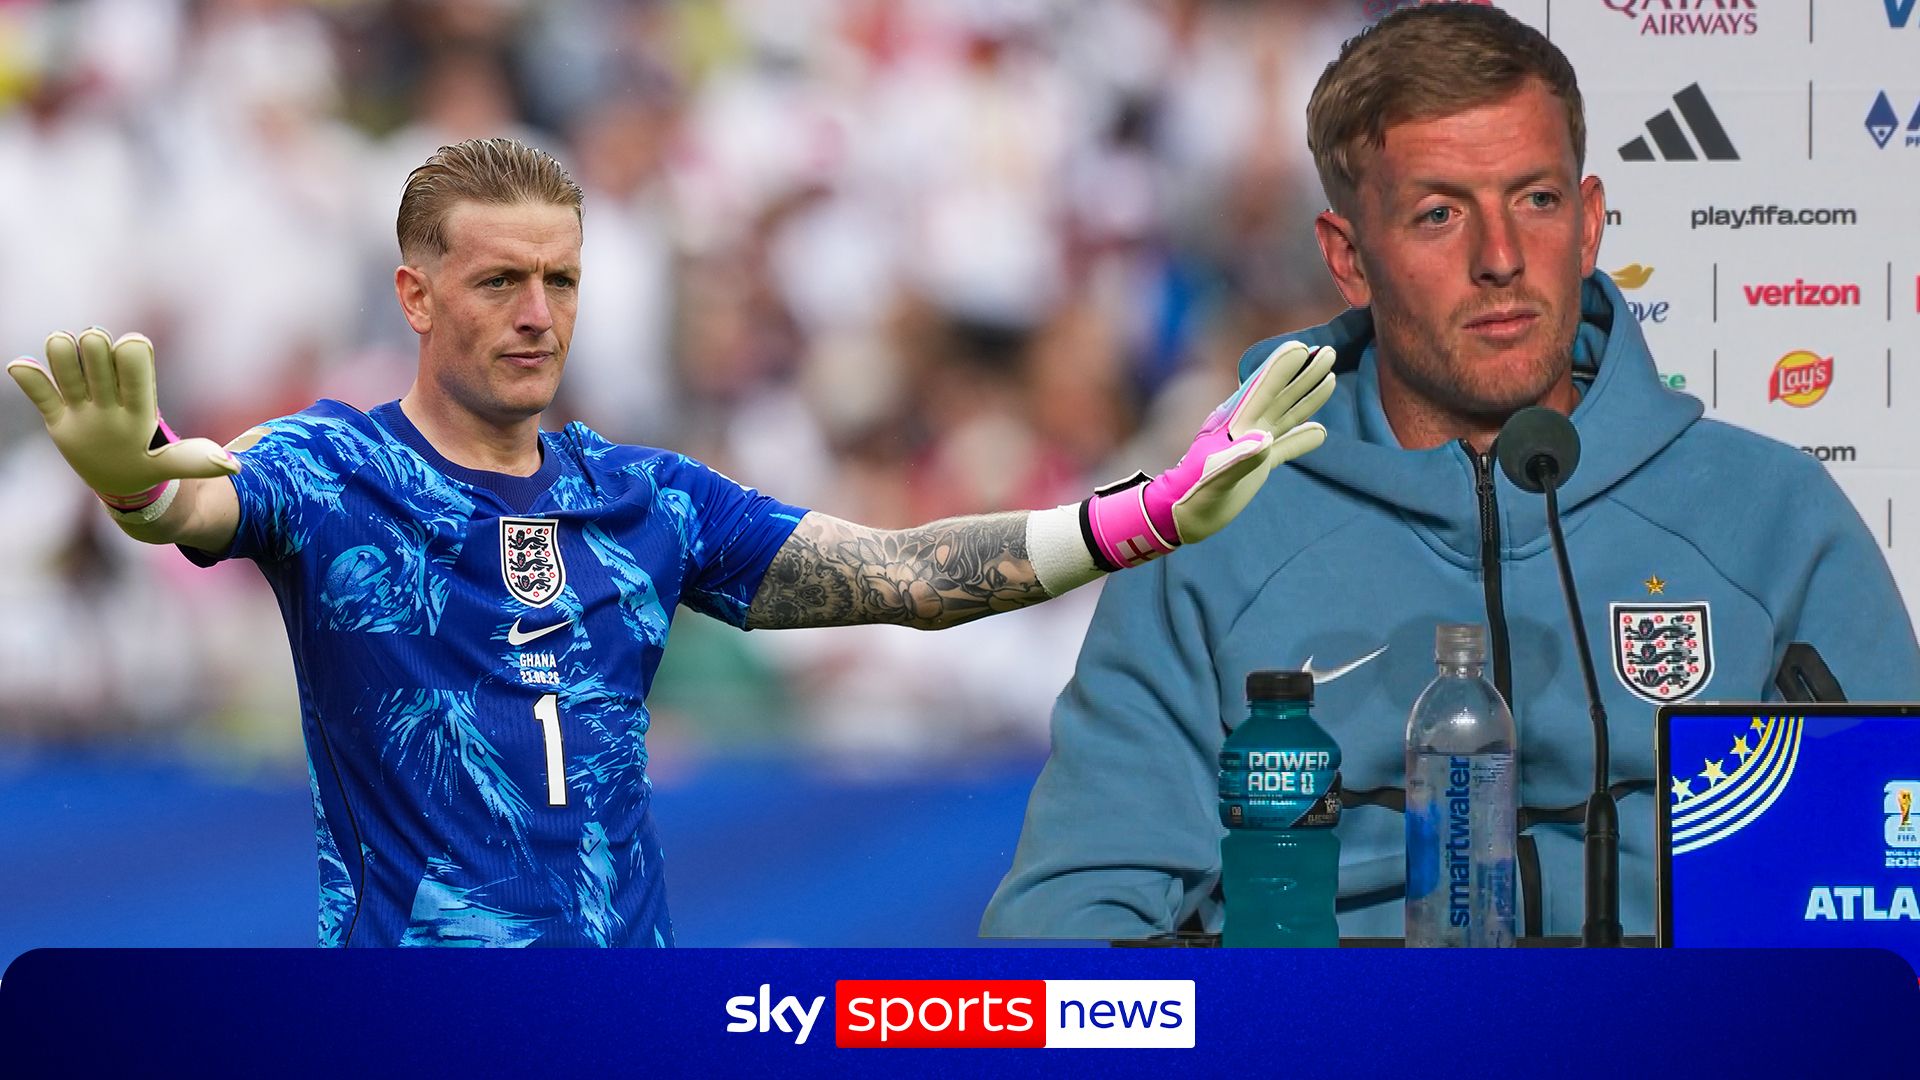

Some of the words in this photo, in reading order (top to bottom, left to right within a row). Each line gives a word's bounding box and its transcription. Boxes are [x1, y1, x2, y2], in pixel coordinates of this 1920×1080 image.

[1640, 13, 1758, 35] AIRWAYS
[1691, 205, 1856, 229] play.fifa.com
[1743, 278, 1860, 306] verizon
[1778, 362, 1827, 395] Lay's
[520, 653, 557, 668] GHANA
[533, 692, 568, 807] 1
[1248, 751, 1330, 770] POWER
[1248, 771, 1296, 791] ADE
[1446, 755, 1470, 928] smartwater
[1897, 834, 1918, 842] FIFA
[1804, 886, 1920, 921] ATLA
